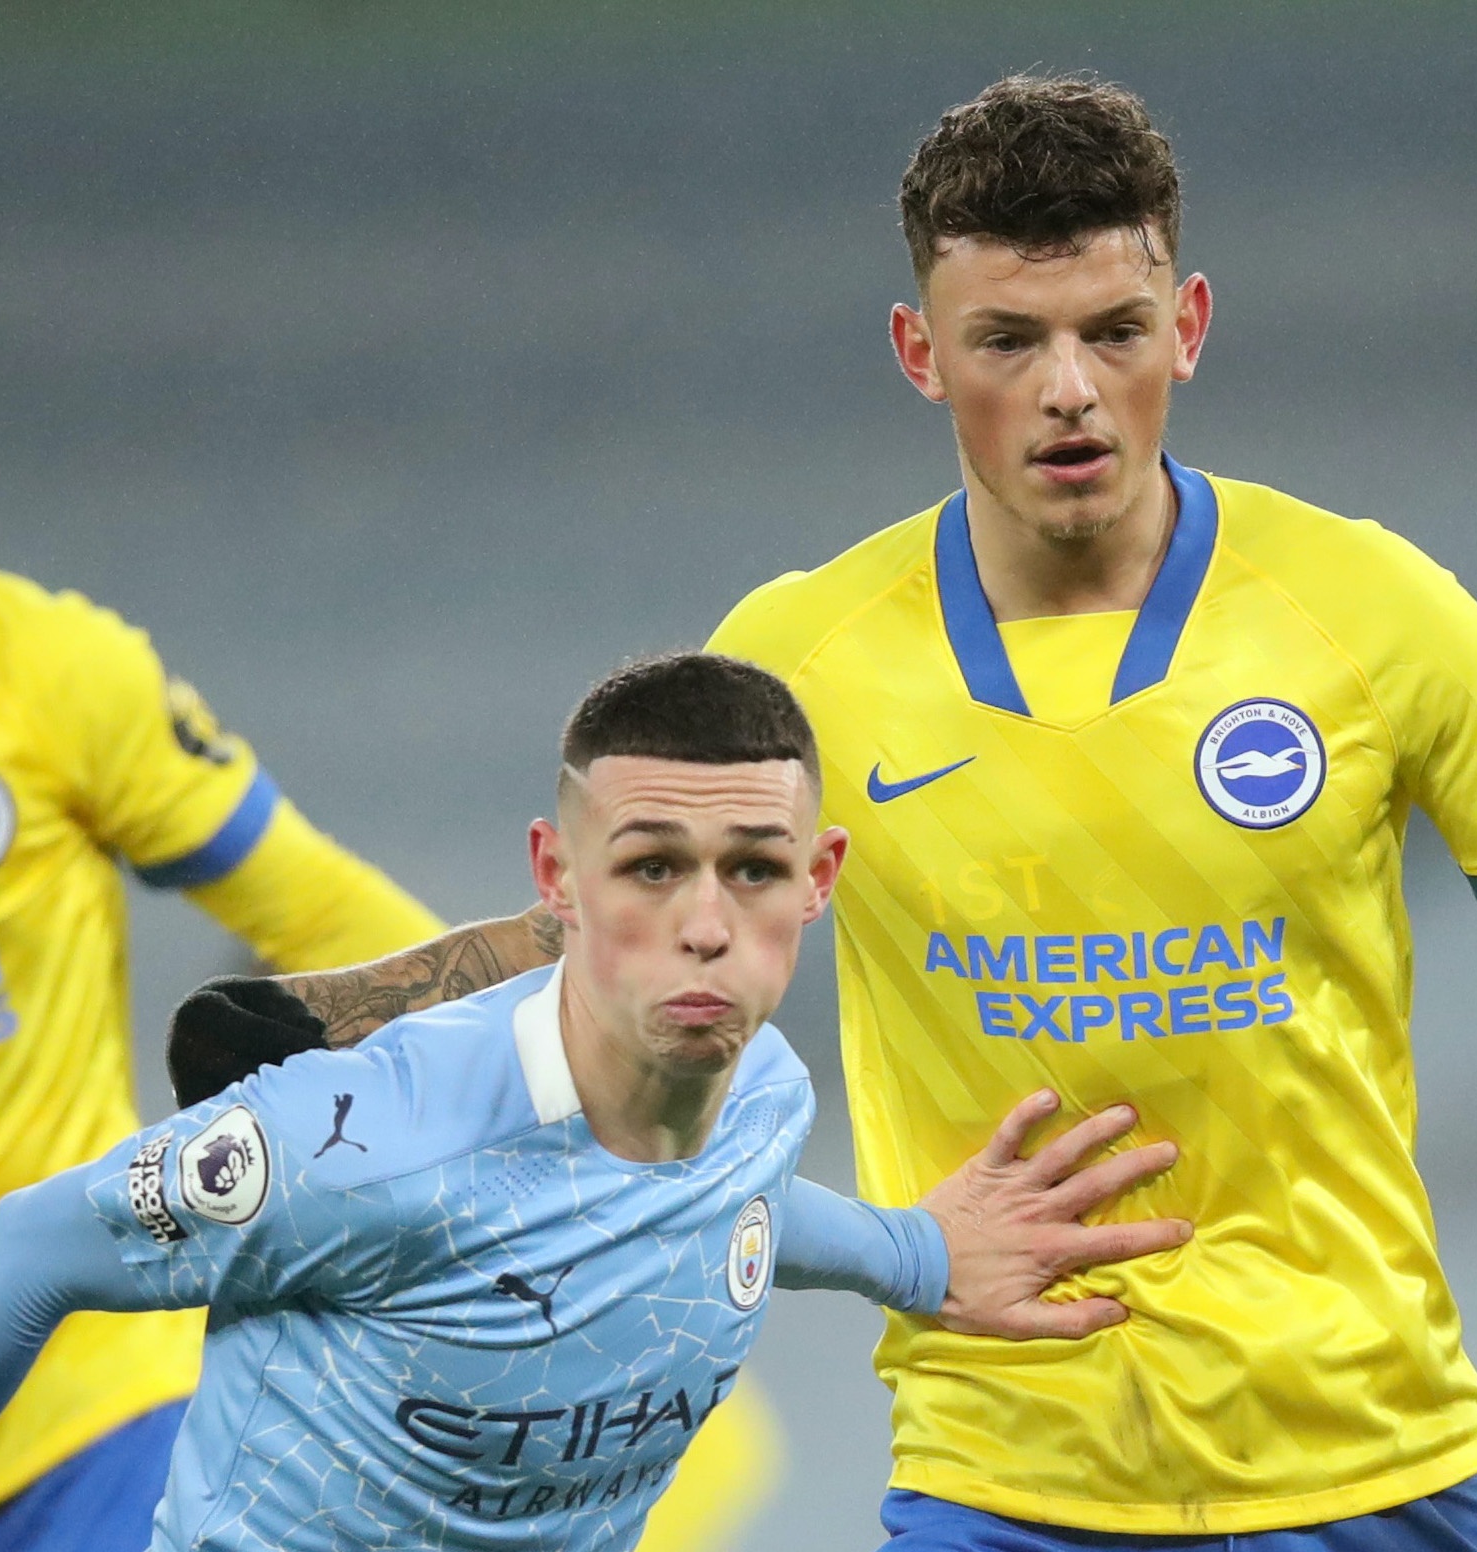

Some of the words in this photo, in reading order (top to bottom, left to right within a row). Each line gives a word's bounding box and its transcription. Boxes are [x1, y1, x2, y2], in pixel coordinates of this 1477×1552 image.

[1210, 708, 1262, 744] BRIGHTON
[1268, 709, 1276, 718] &
[1281, 712, 1308, 737] HOVE
[1242, 805, 1290, 819] ALBION
[925, 917, 1286, 983] AMERICAN
[975, 973, 1294, 1043] EXPRESS
